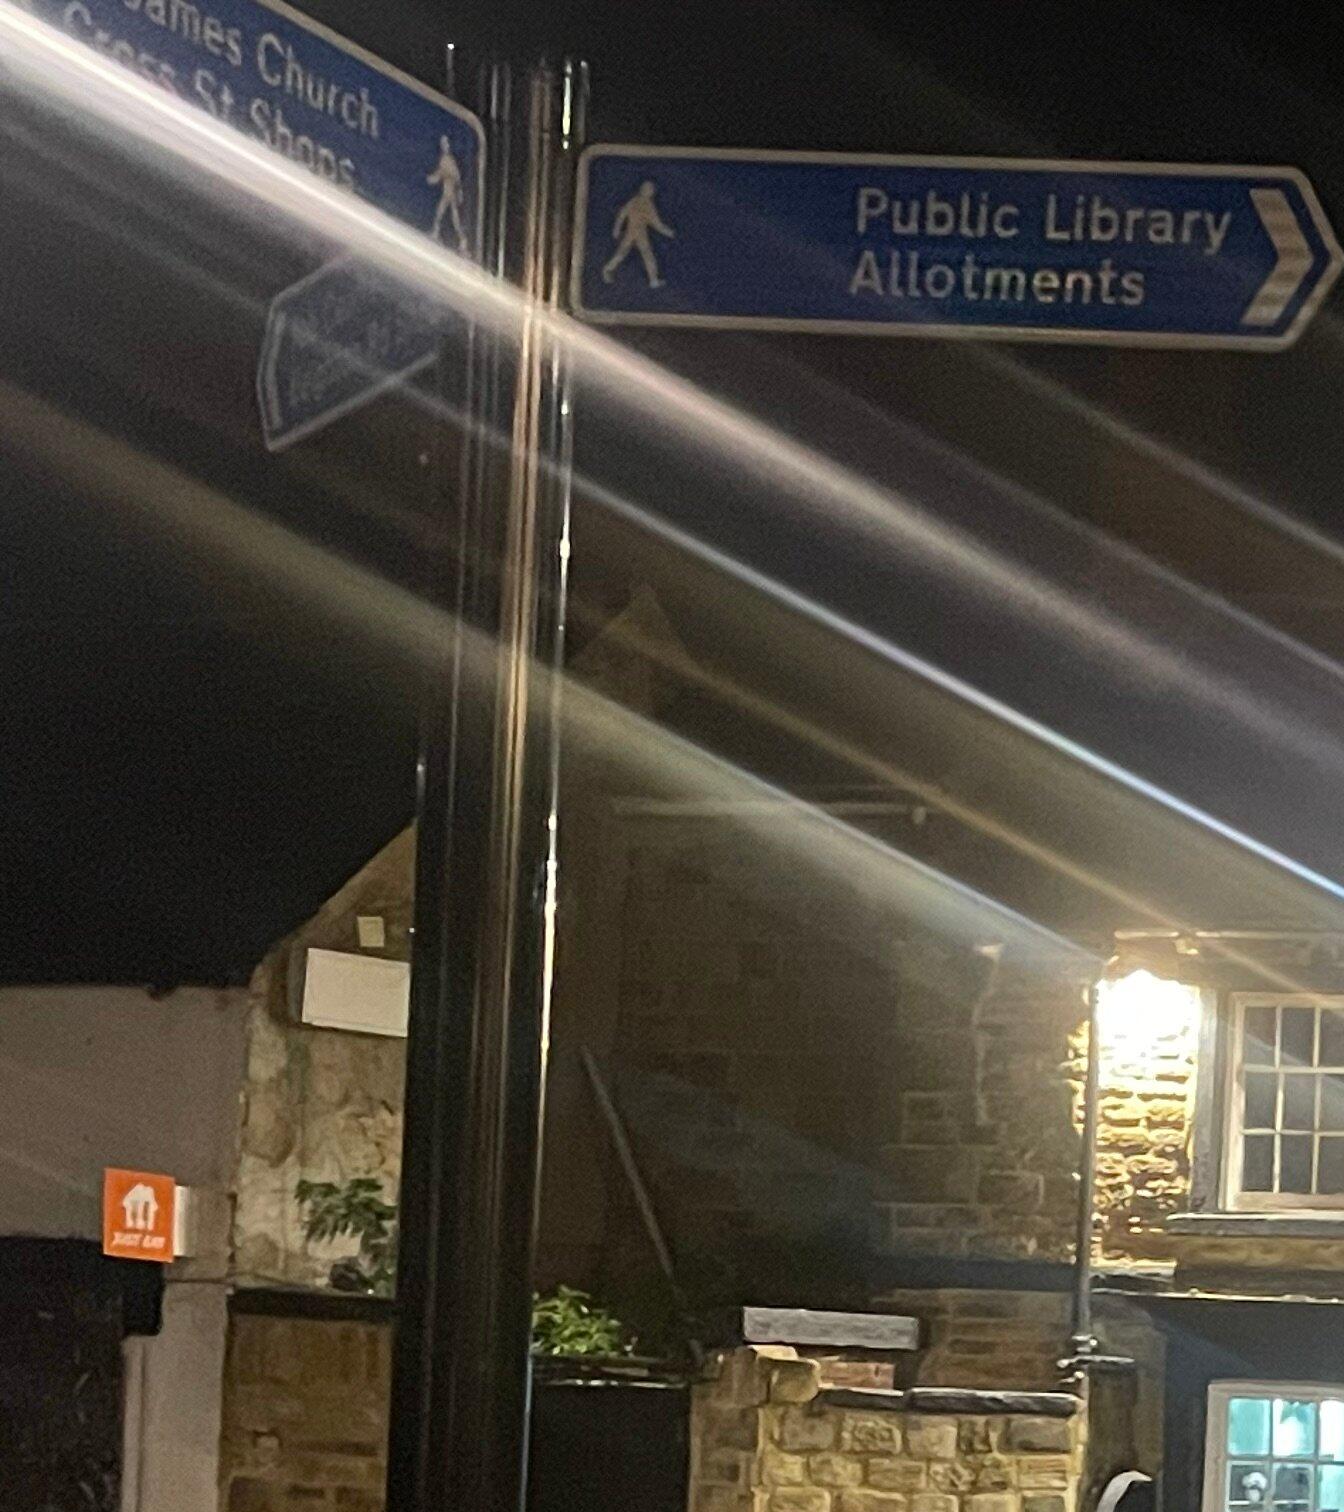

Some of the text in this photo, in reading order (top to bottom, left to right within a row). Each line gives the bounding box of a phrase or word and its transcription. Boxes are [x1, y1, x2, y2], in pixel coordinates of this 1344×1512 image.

[123, 0, 379, 139] ames Church
[855, 186, 1232, 255] Public Library
[849, 249, 1147, 307] Allotments
